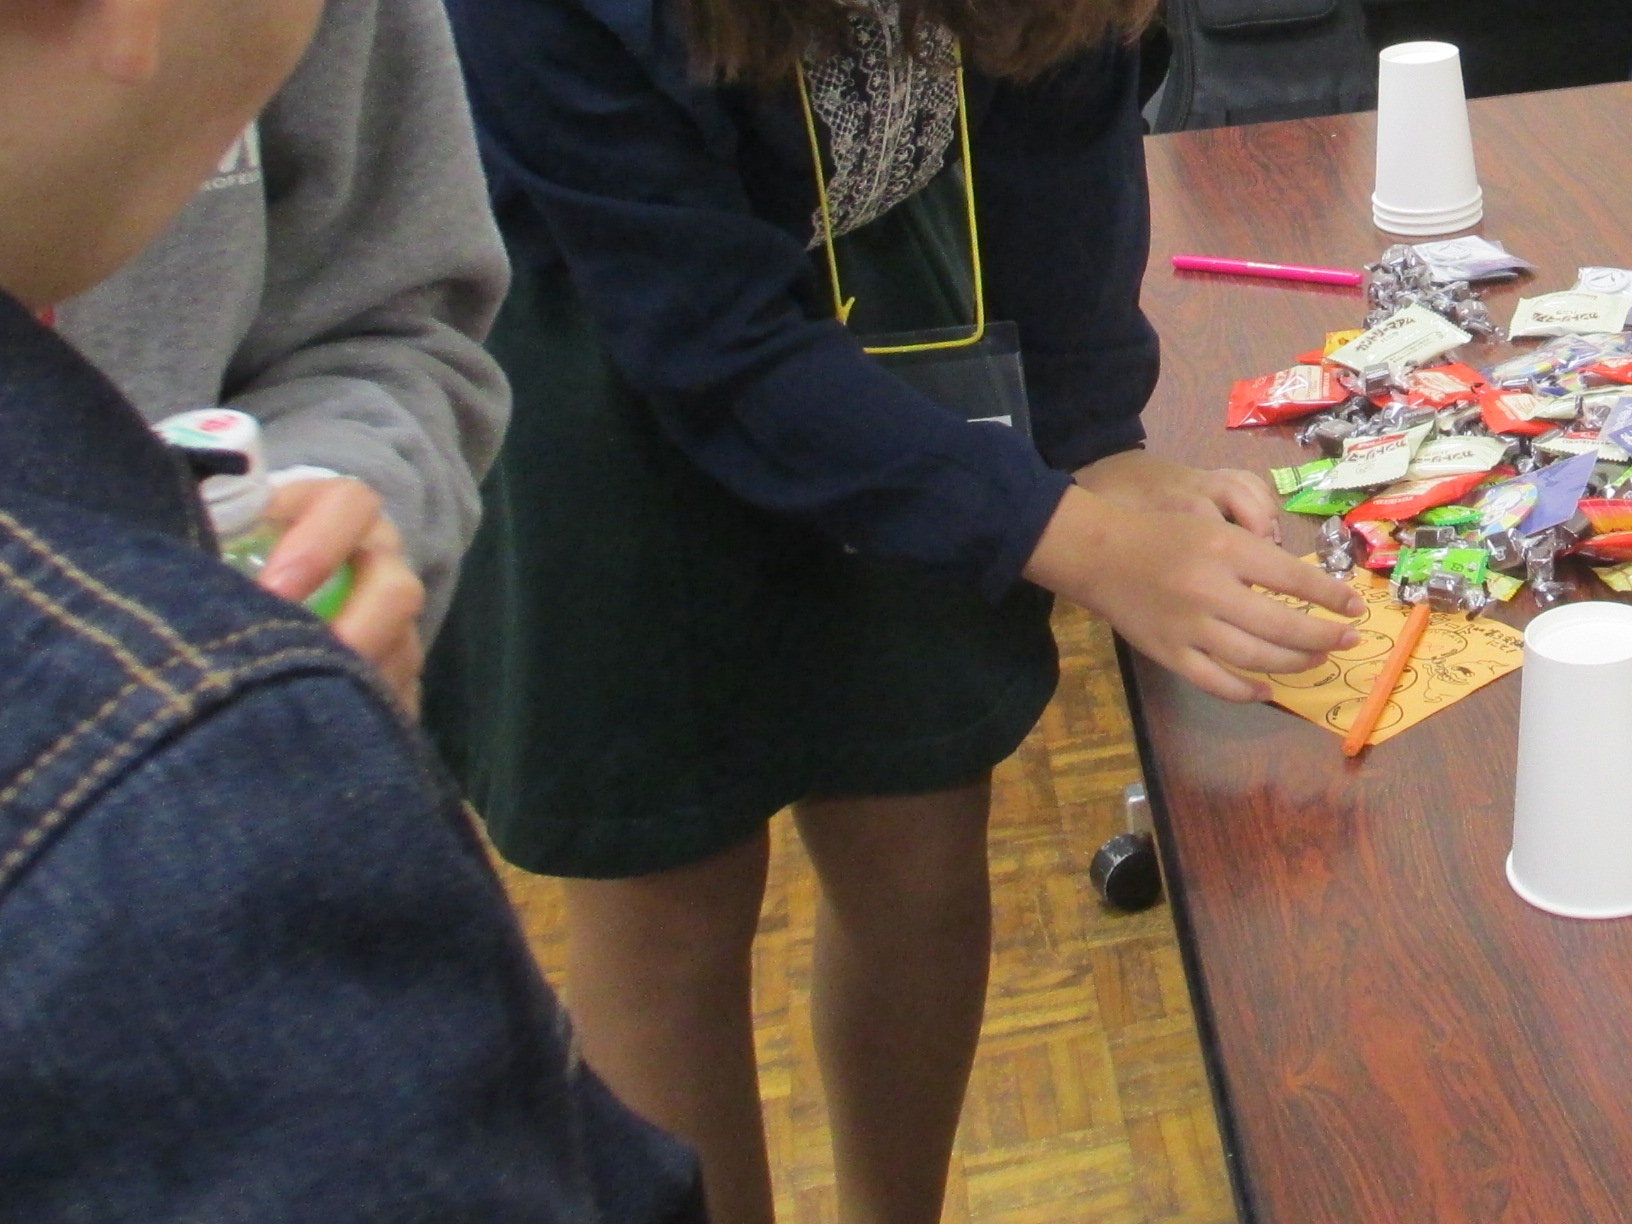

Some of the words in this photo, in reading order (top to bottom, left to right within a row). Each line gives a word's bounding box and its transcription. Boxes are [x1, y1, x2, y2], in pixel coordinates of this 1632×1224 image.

[1356, 317, 1417, 352] カントリーマアム
